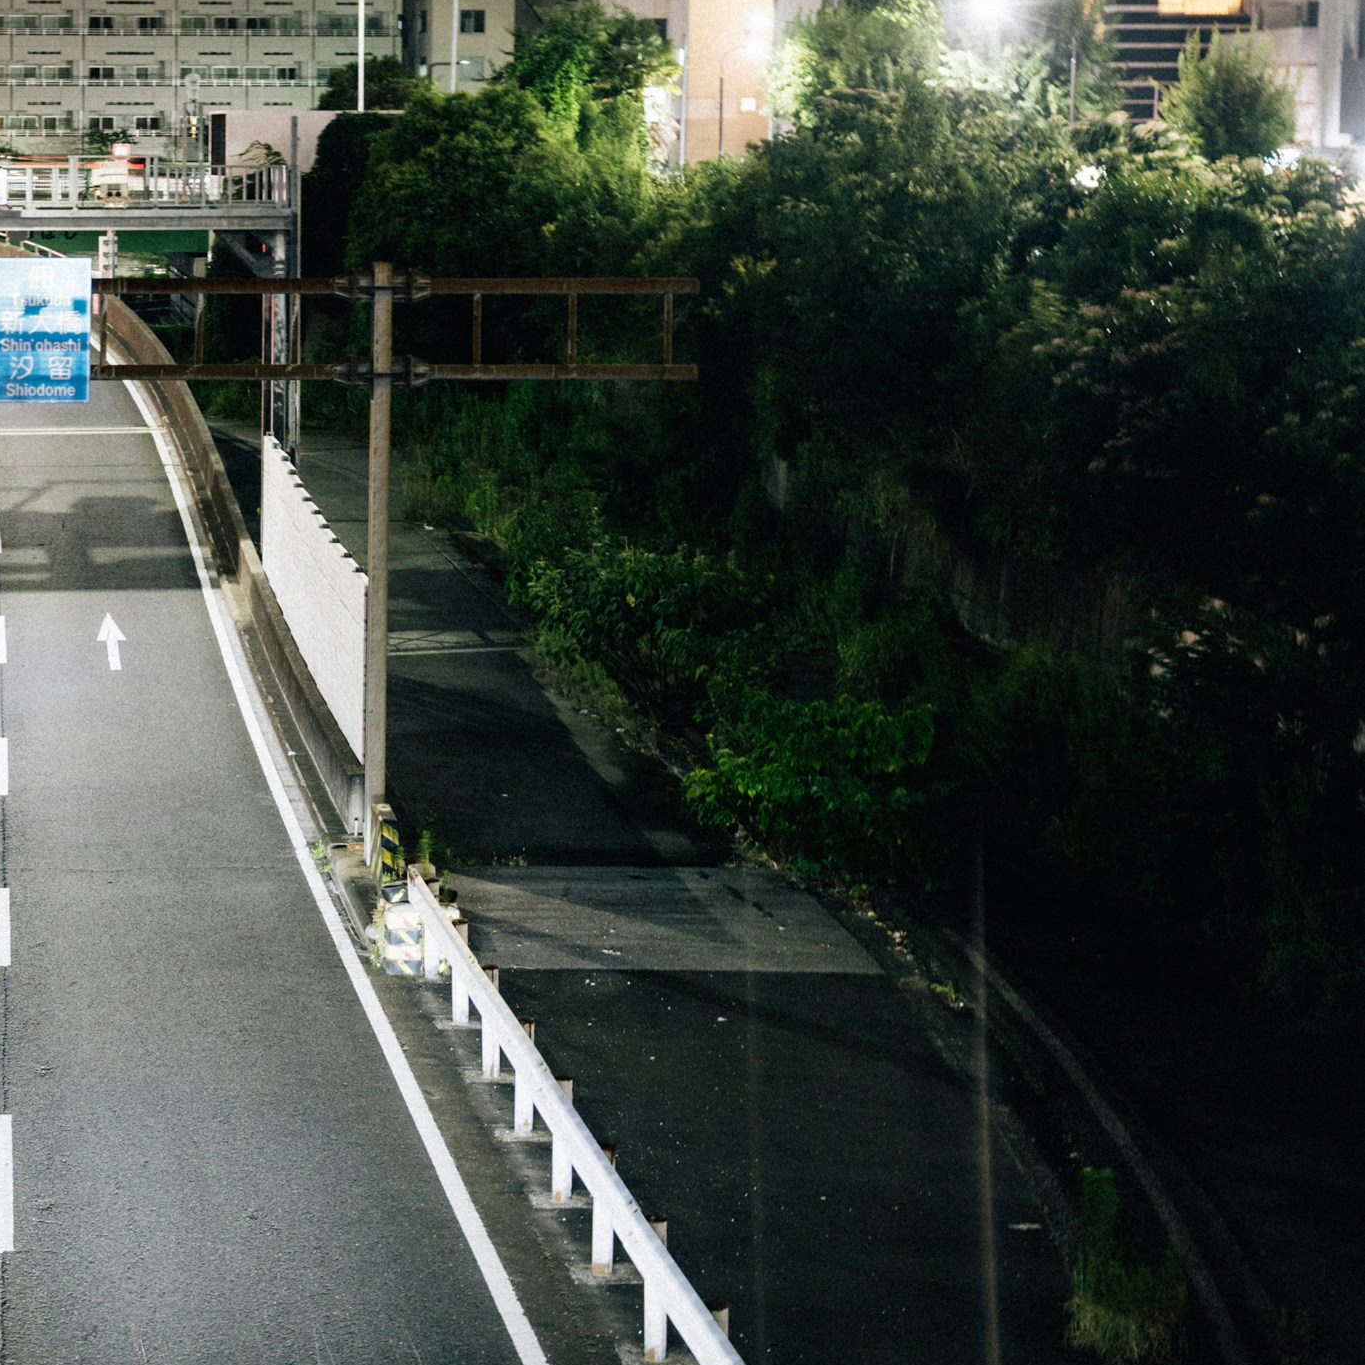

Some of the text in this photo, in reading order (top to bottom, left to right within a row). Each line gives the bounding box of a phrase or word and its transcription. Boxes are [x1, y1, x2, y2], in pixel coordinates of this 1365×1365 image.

[11, 293, 72, 306] Tsukuda
[1, 310, 82, 335] 新大橋
[10, 355, 73, 380] 汐留
[6, 383, 76, 397] Shiodome
